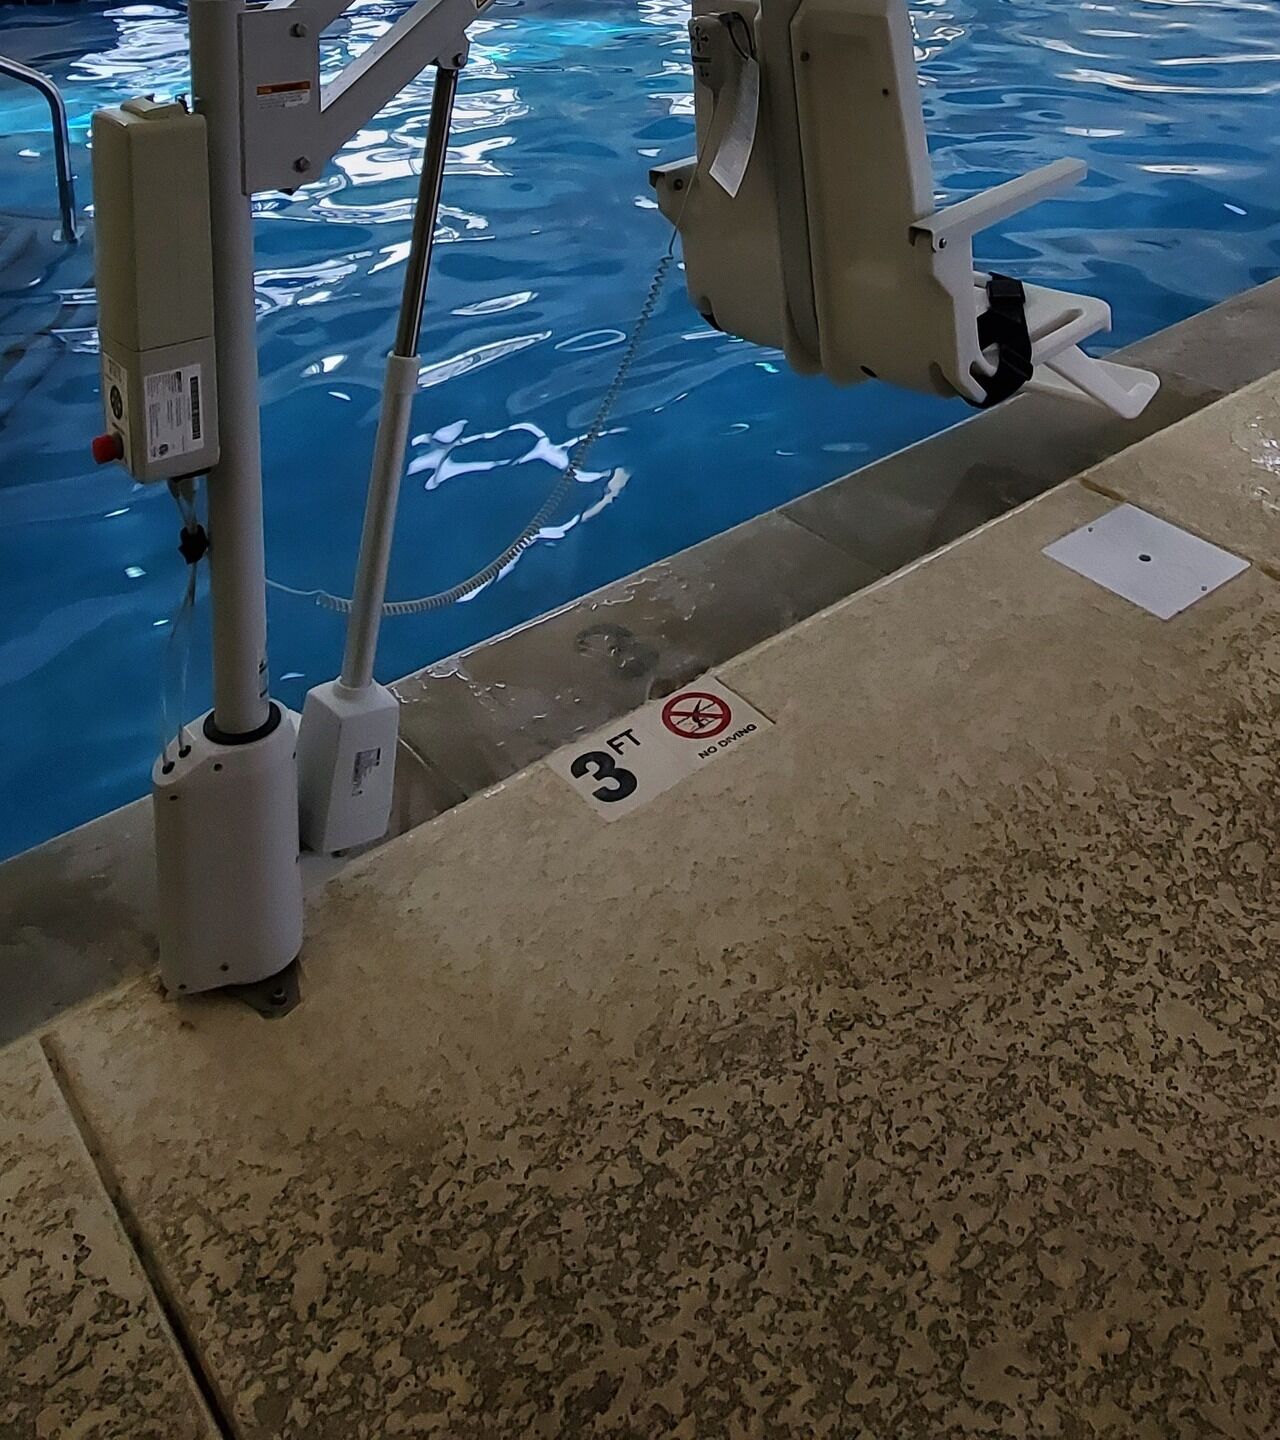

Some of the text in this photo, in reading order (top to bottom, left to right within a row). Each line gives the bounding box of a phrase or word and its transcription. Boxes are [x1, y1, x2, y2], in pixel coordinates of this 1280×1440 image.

[570, 728, 641, 803] 3 FT
[698, 723, 758, 759] NO DIVING
